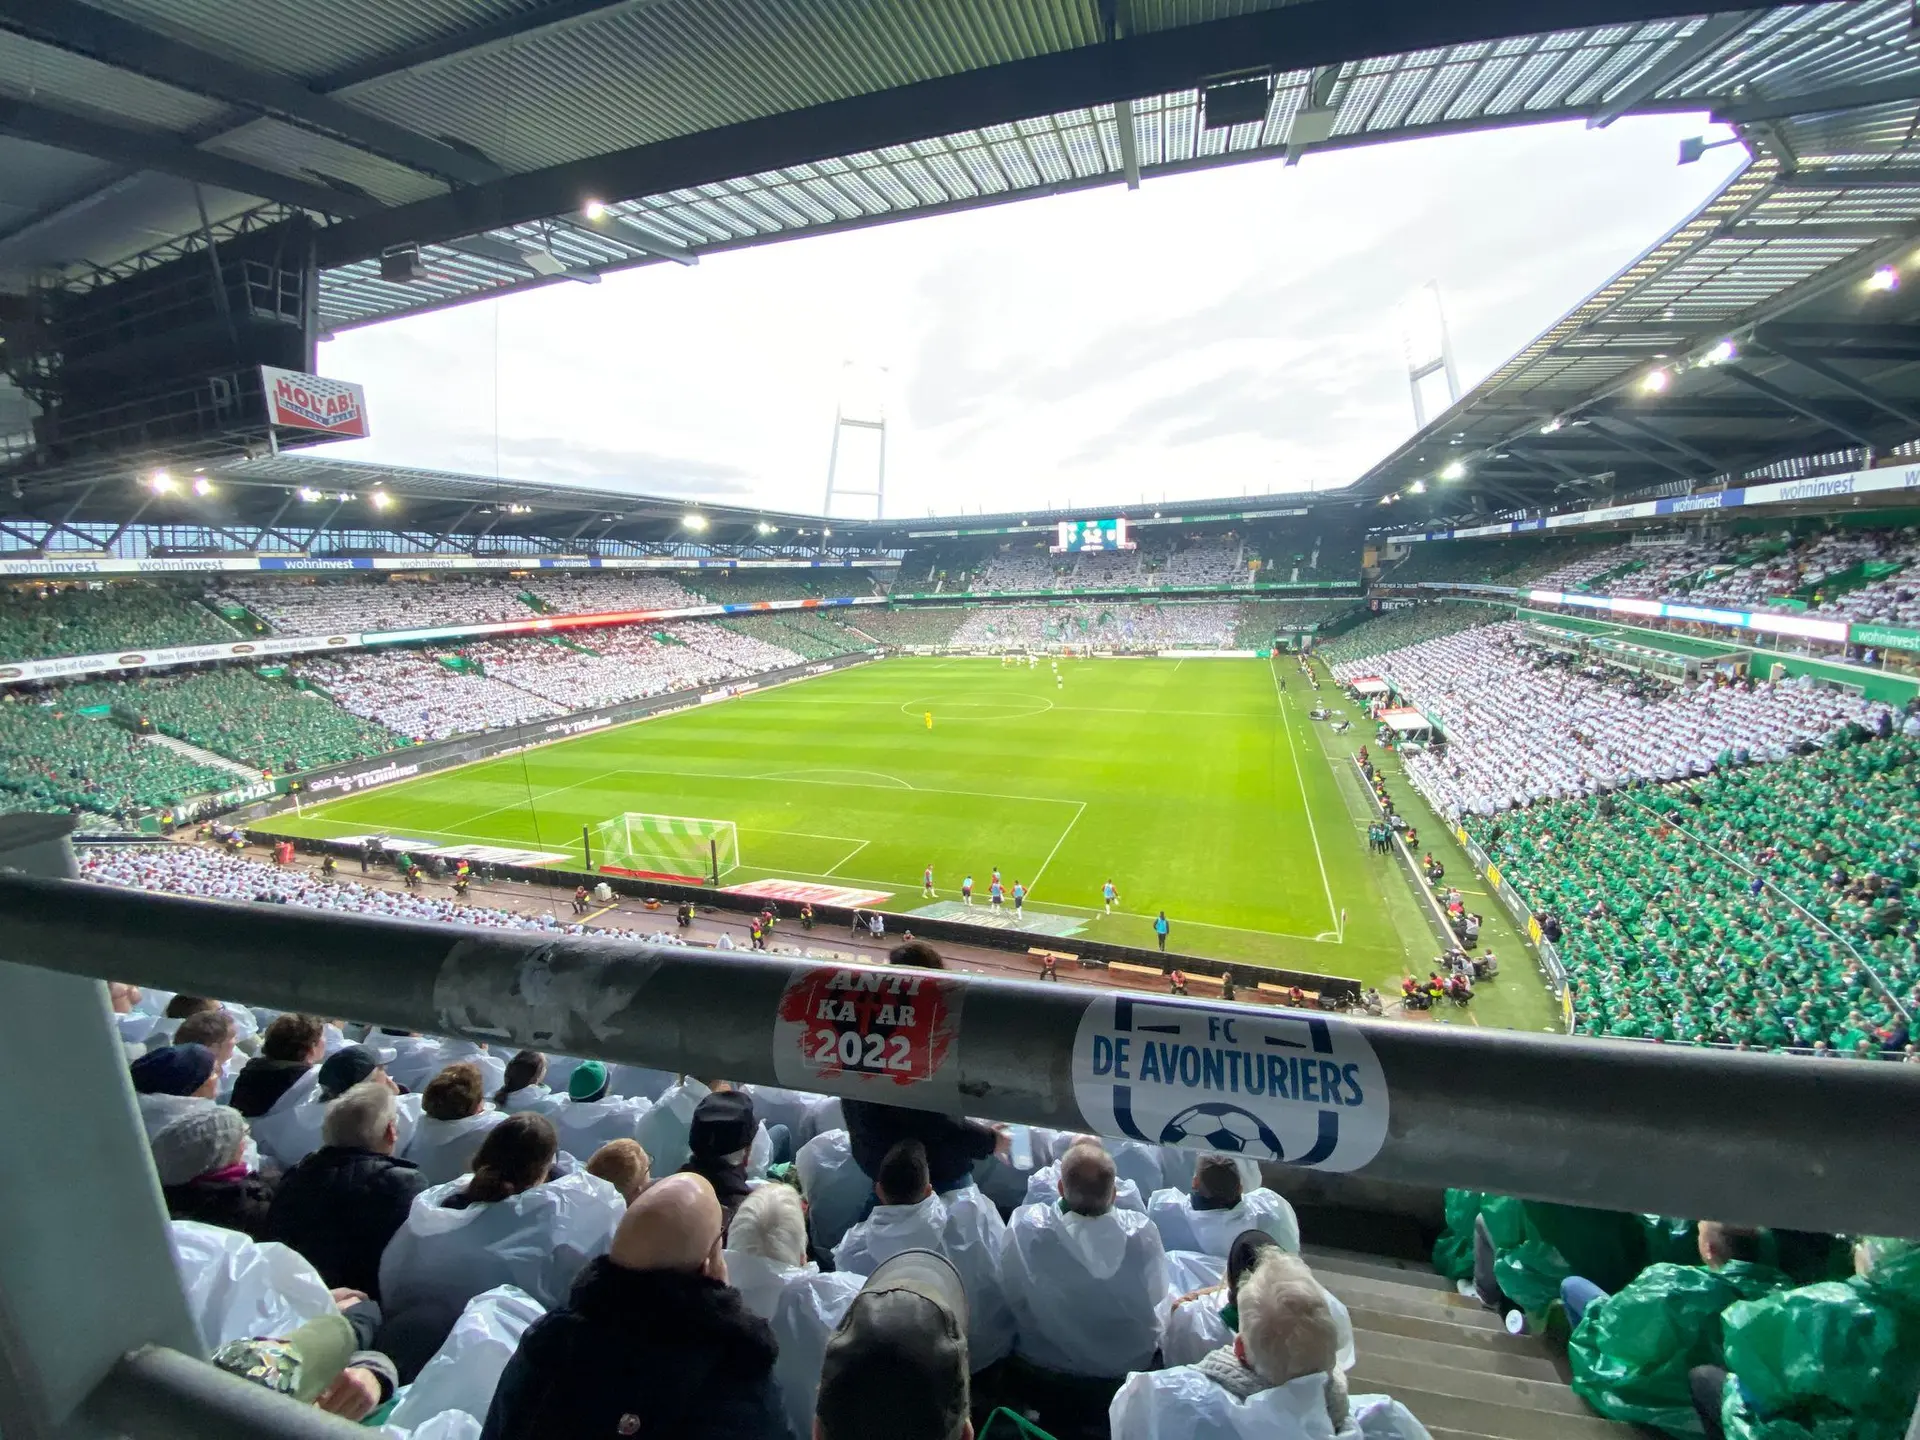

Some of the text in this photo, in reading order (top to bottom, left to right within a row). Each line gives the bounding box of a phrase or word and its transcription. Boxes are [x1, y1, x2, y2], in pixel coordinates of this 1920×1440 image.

[1780, 475, 1855, 500] wohninvest
[1673, 493, 1722, 512] wohninvest
[5, 560, 98, 573] wohninvest
[139, 559, 224, 571] wohninvest
[285, 559, 354, 569] wohninvest
[401, 559, 454, 569] wohninvest
[476, 559, 522, 568] wohninvest
[552, 559, 591, 568] wohninvest
[1858, 629, 1920, 651] wohninvest
[826, 970, 926, 996] ANTI
[1208, 1016, 1237, 1044] FC
[814, 1029, 912, 1072] 2022
[1092, 1034, 1364, 1107] DE AVONTURIERS
